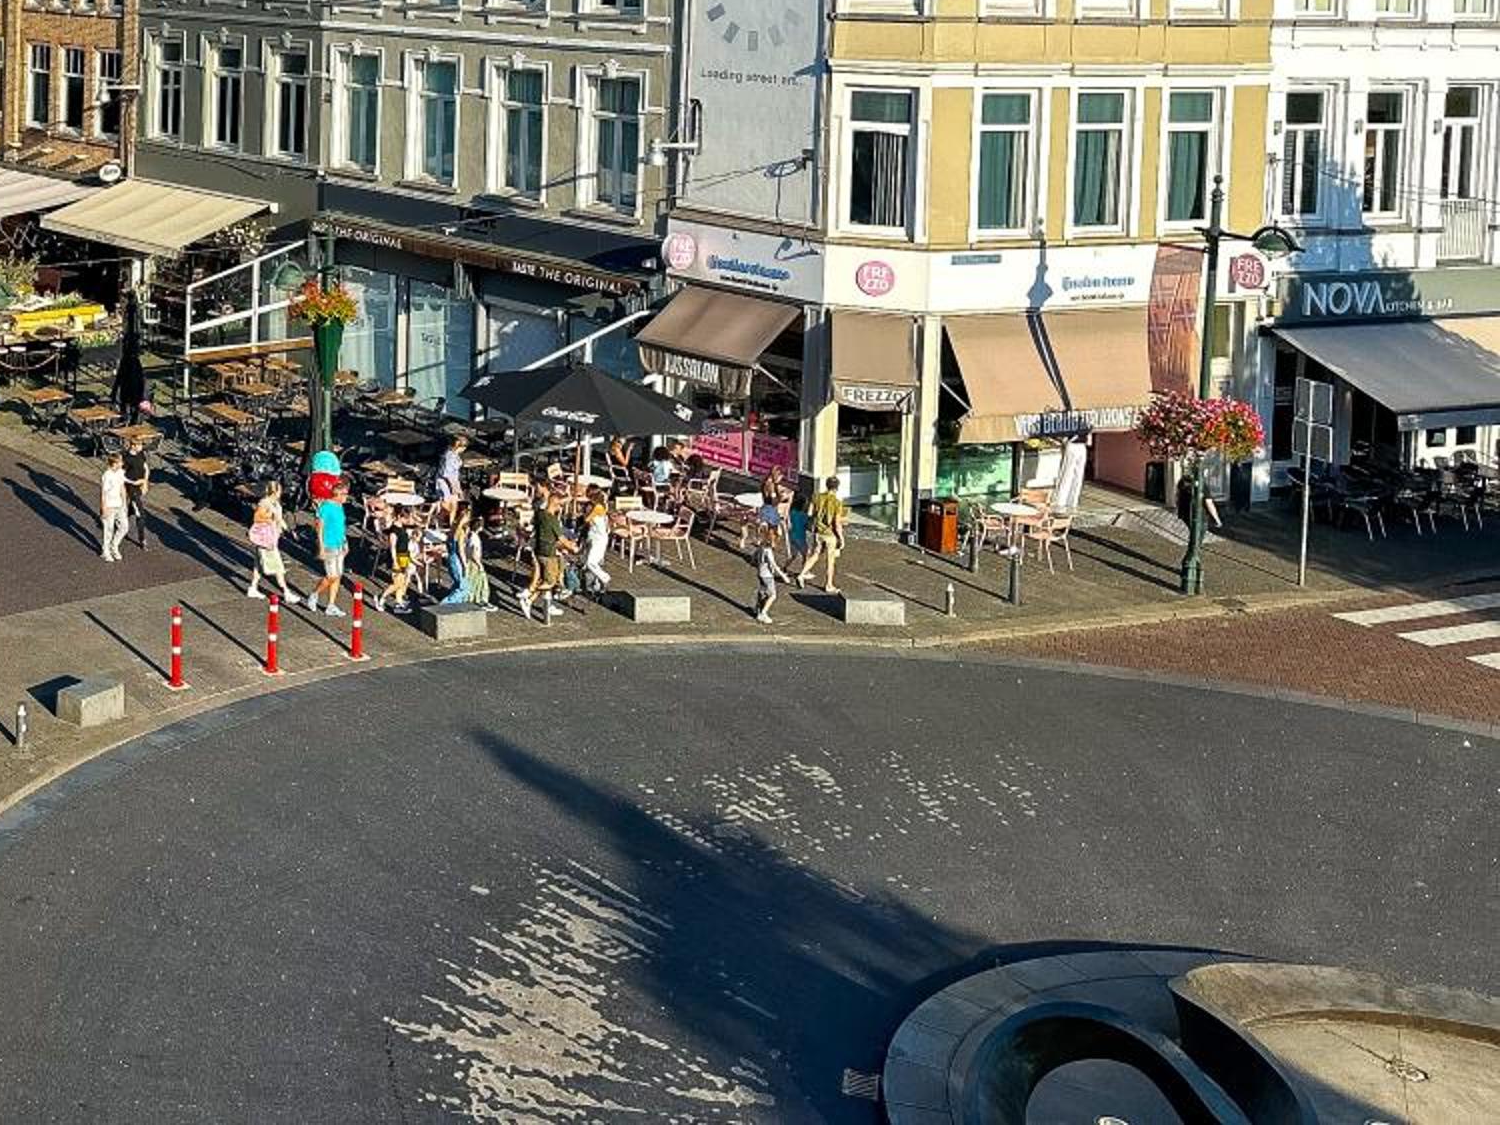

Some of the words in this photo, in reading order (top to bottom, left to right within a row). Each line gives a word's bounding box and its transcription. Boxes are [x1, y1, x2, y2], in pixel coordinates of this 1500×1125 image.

[1237, 258, 1261, 272] FRE
[539, 266, 561, 282] THE
[563, 272, 623, 295] ORIGINAL
[1302, 281, 1386, 316] NOVA
